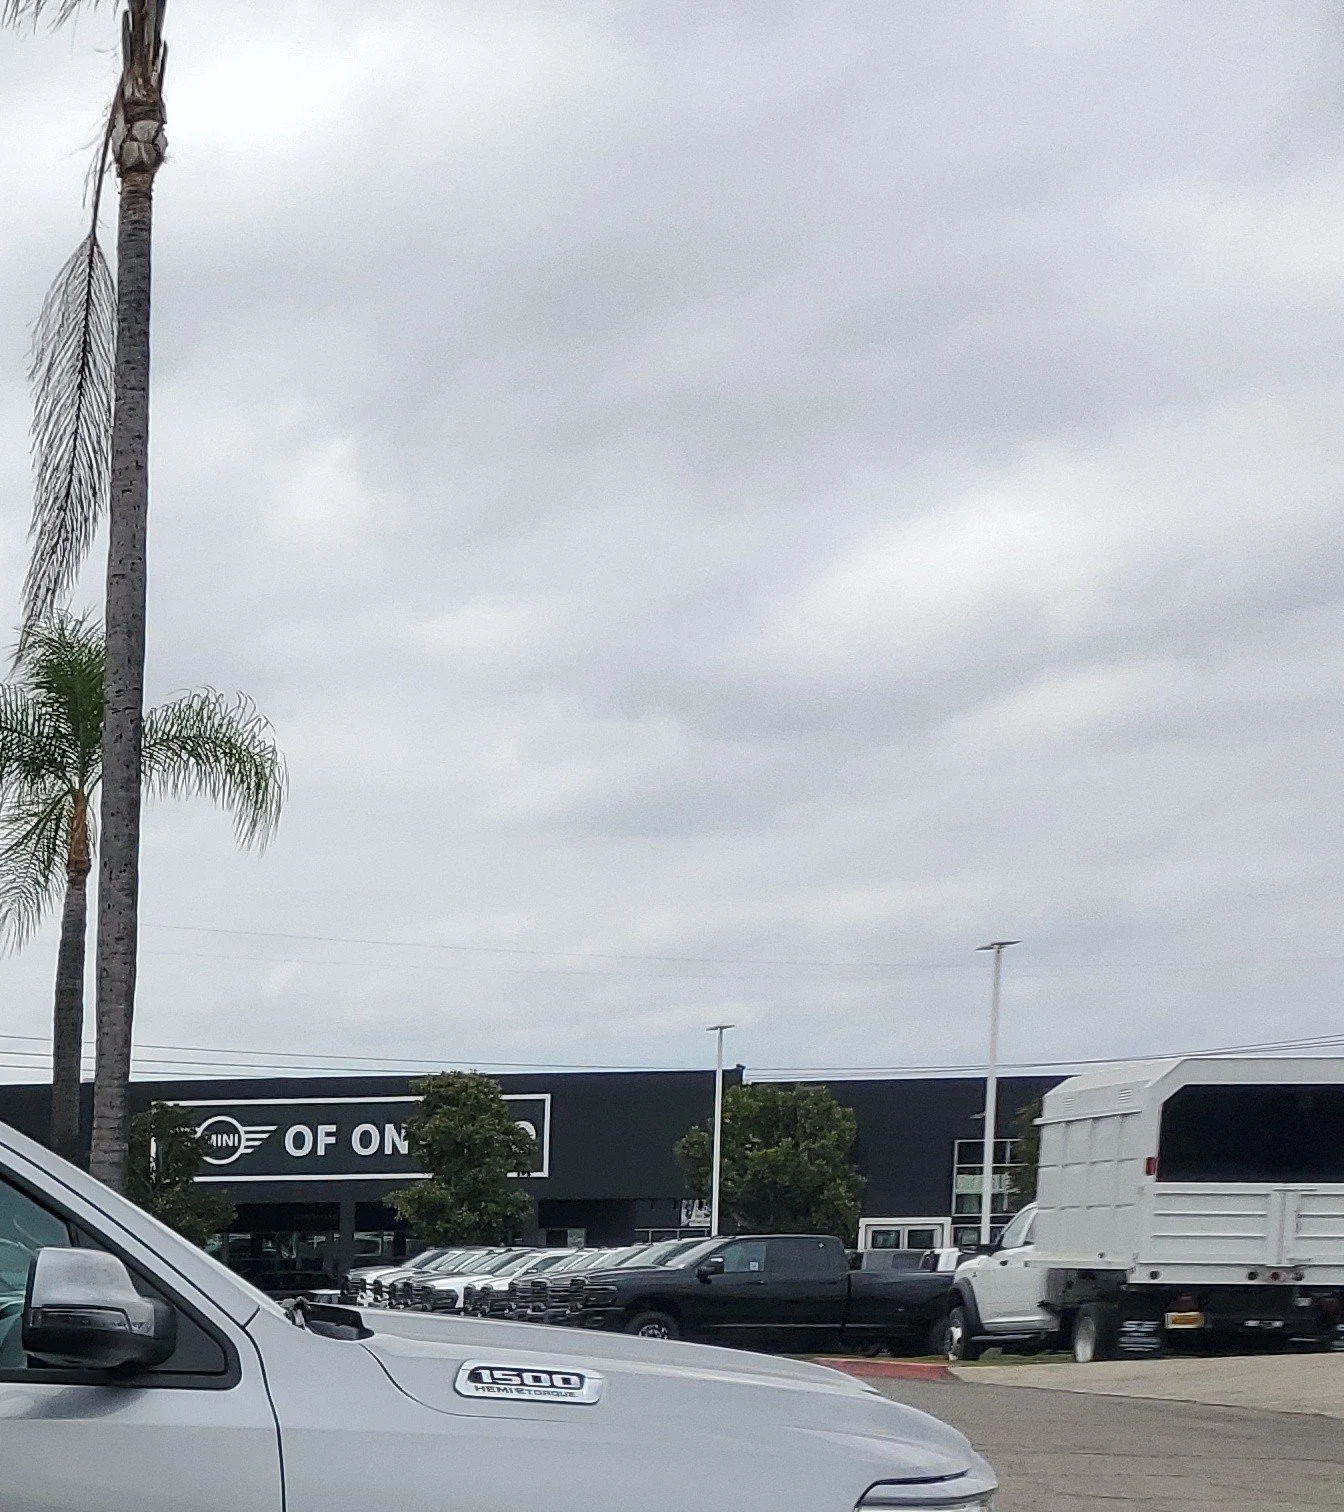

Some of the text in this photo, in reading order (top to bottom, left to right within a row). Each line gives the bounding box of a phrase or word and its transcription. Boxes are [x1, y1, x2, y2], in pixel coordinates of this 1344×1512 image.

[284, 1124, 337, 1157] OF
[472, 1368, 582, 1388] 1500
[474, 1385, 513, 1394] HEMI
